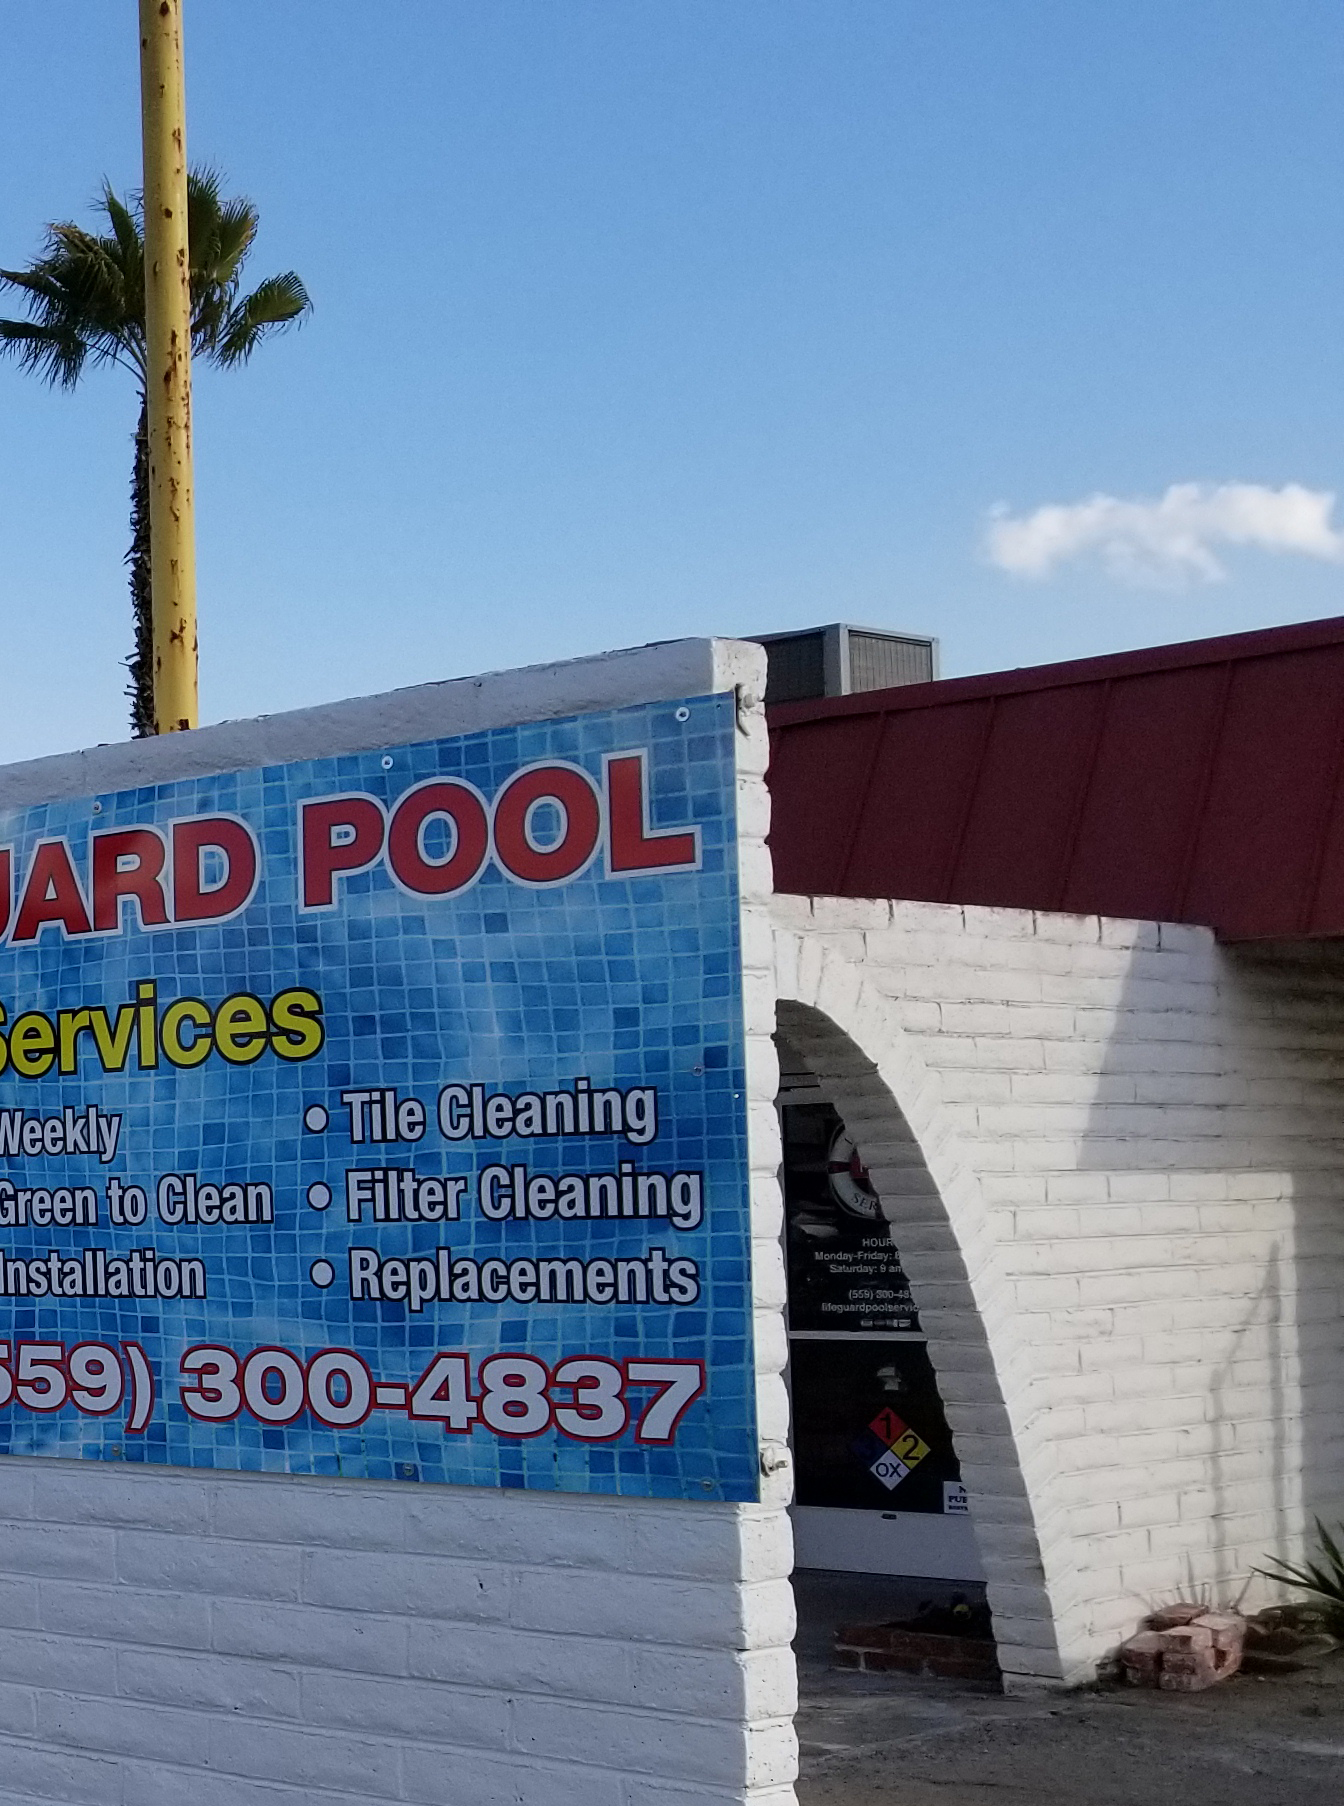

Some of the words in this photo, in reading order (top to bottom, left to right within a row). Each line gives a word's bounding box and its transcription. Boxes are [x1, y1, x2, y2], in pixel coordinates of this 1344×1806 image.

[297, 748, 701, 913] POOL
[343, 1089, 426, 1146] Tile
[436, 1077, 657, 1147] Cleaning
[105, 1179, 147, 1226] to
[153, 1172, 274, 1225] Clean
[344, 1169, 469, 1226] Filter
[476, 1161, 701, 1231] Cleaning
[815, 1251, 893, 1262] Monday-Friday:
[829, 1264, 877, 1275] Saturday:
[348, 1245, 700, 1313] Replacements
[848, 1289, 874, 1300] (559)
[876, 1289, 911, 1299] 300-48
[179, 1342, 706, 1446] 300-4837
[880, 1413, 892, 1440] 1
[902, 1434, 921, 1461] 2
[875, 1462, 903, 1478] OX
